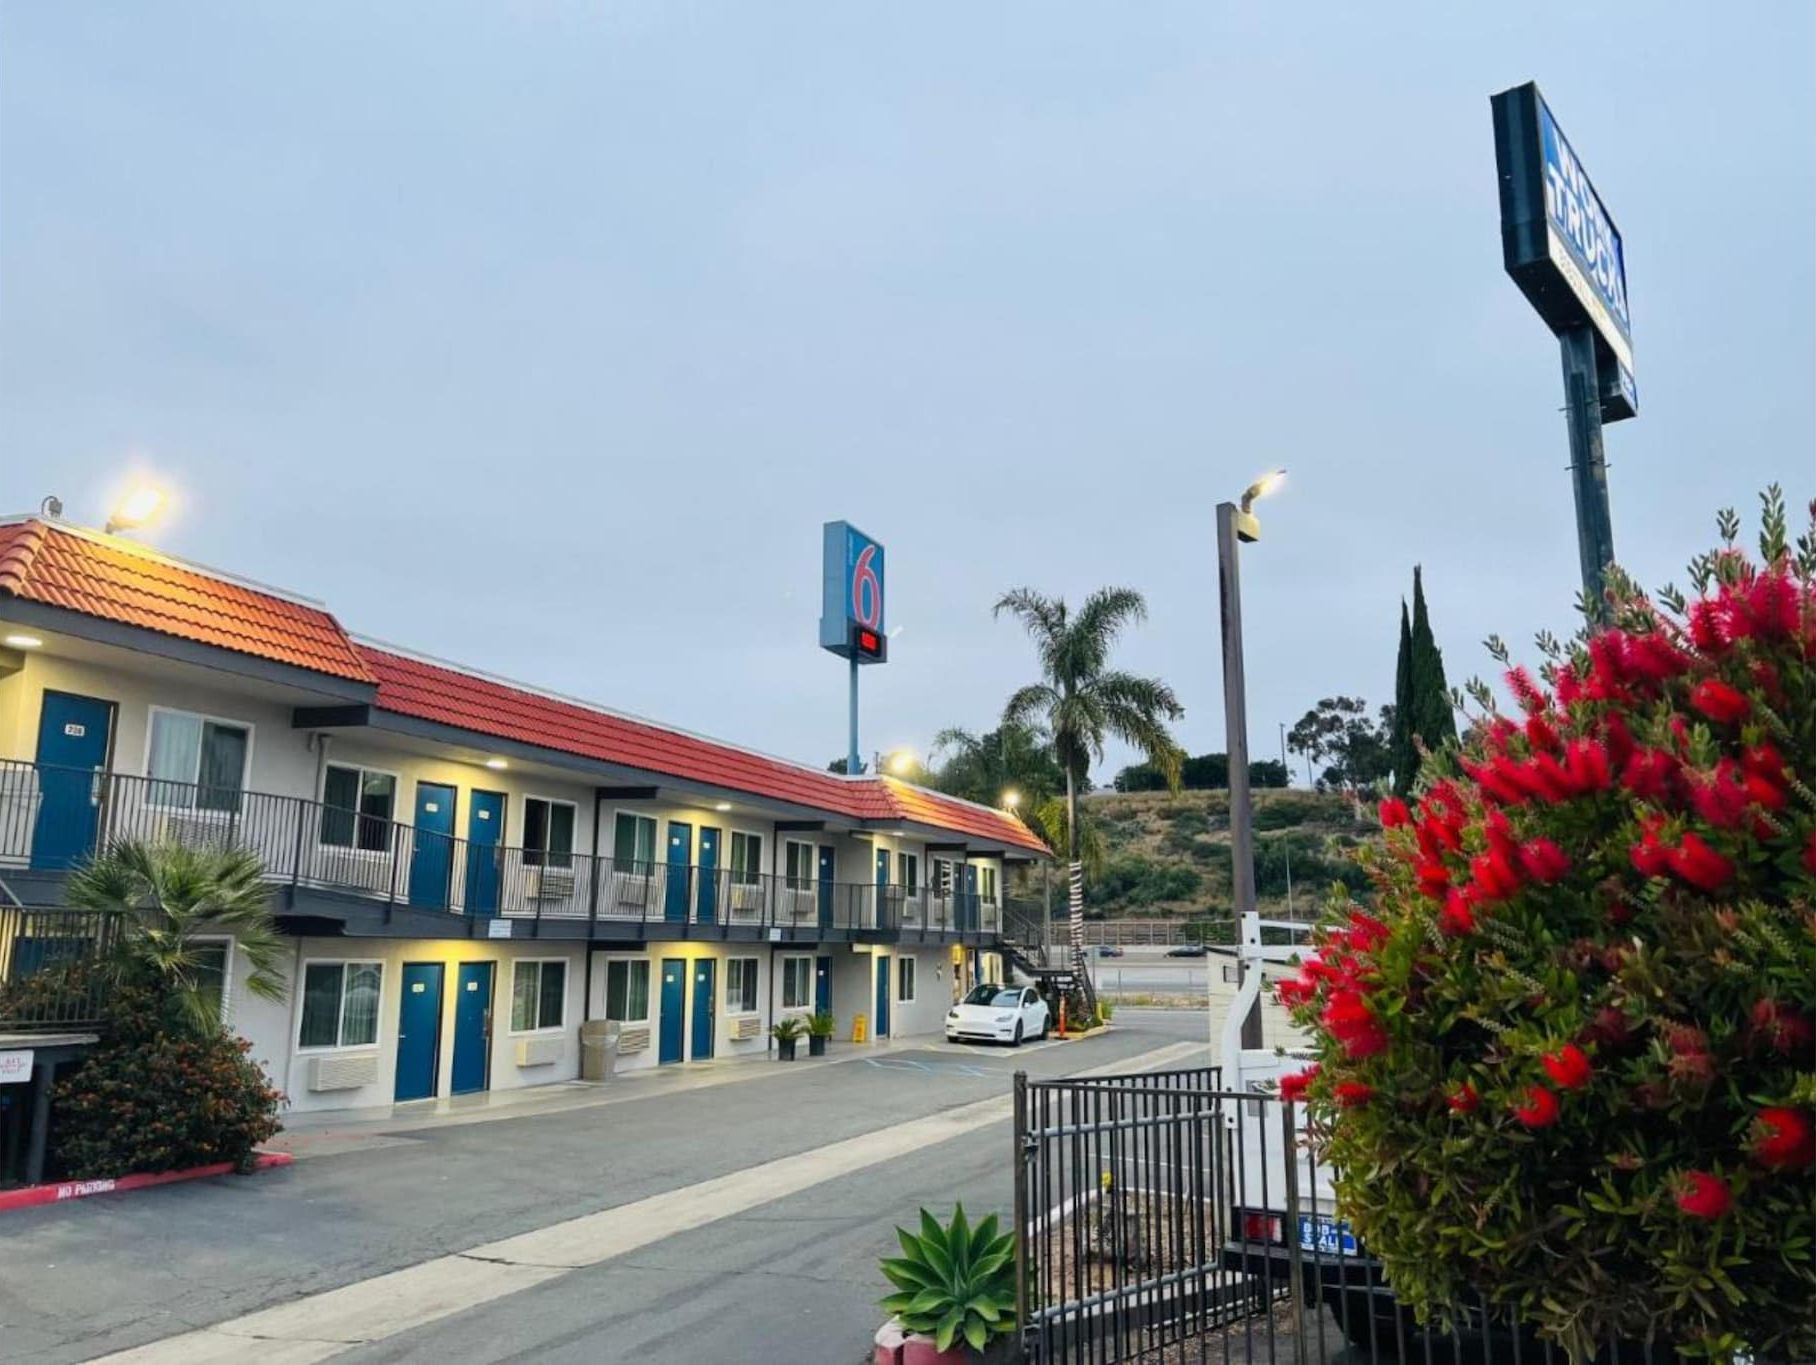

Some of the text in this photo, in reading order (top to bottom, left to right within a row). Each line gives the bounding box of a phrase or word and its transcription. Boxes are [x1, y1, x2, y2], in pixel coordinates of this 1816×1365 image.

[853, 544, 880, 631] 6
[58, 1179, 115, 1199] NO PARKING
[1303, 1222, 1329, 1235] BB
